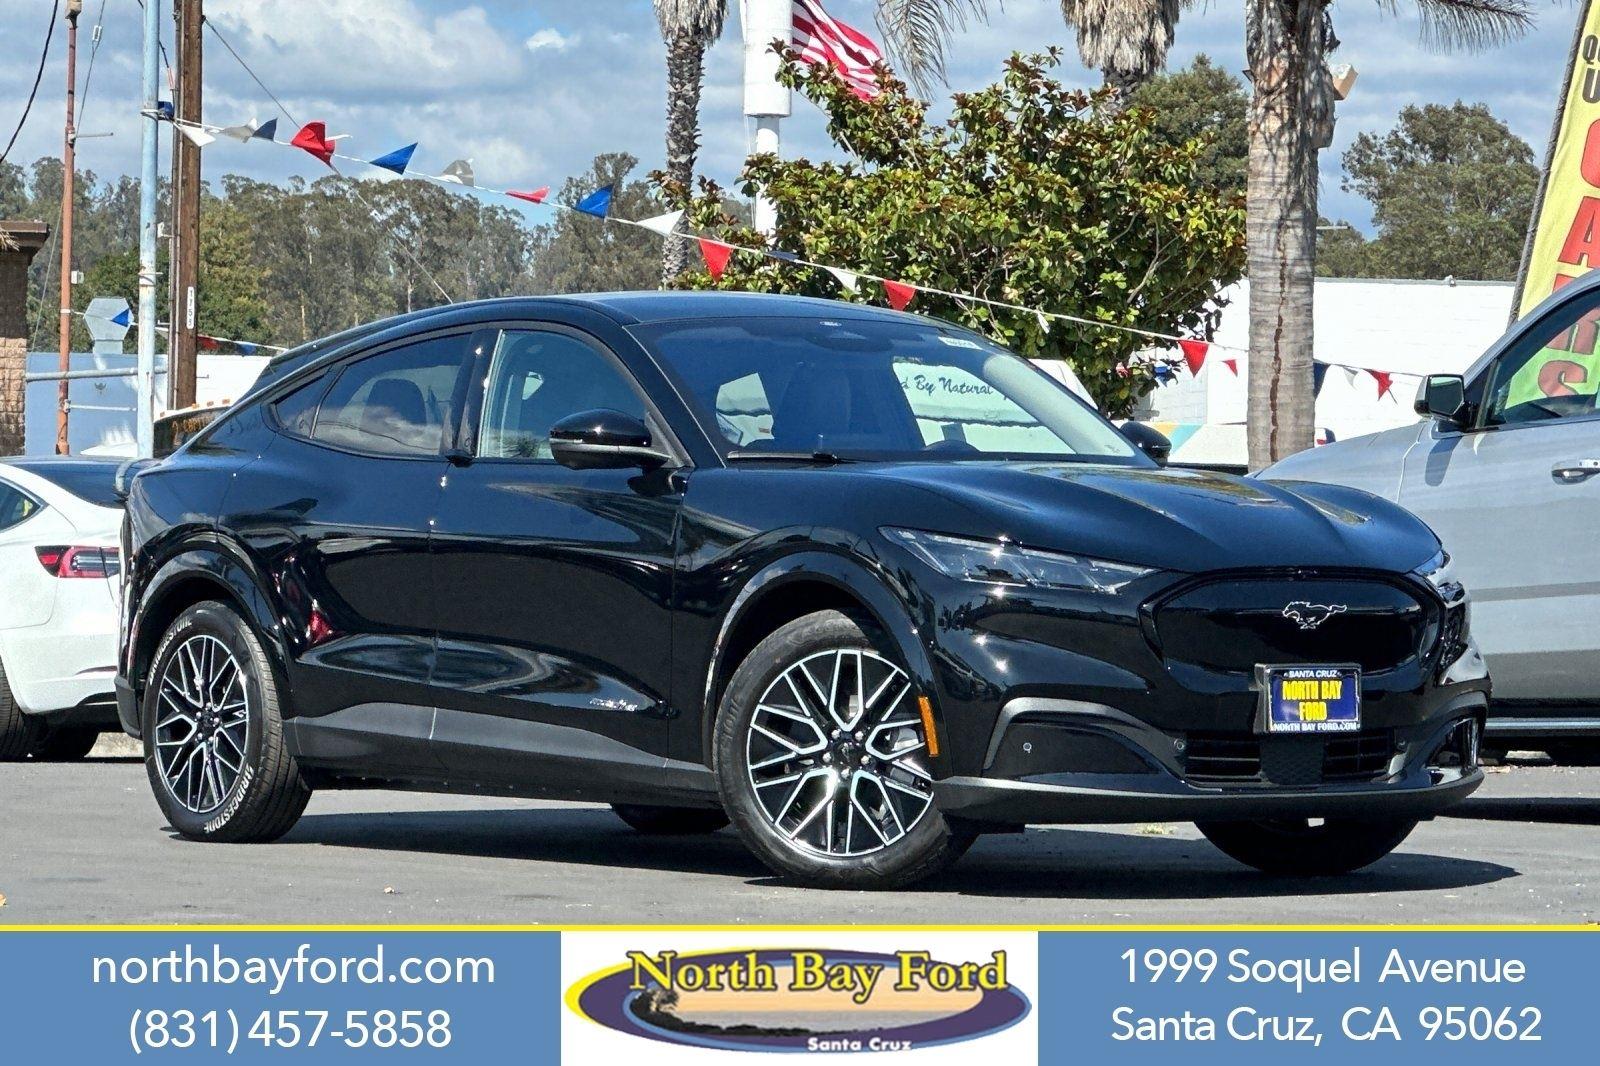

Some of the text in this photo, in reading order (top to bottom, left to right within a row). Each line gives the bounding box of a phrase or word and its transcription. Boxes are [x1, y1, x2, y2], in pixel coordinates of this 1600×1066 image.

[913, 374, 936, 396] By
[1289, 670, 1337, 678] SANTA CRUZ
[1282, 680, 1342, 700] NORTH BAY
[1299, 701, 1327, 721] FORD
[1273, 722, 1300, 731] NORTH
[1301, 722, 1317, 731] BAY
[204, 763, 255, 834] BRIDGESTONE
